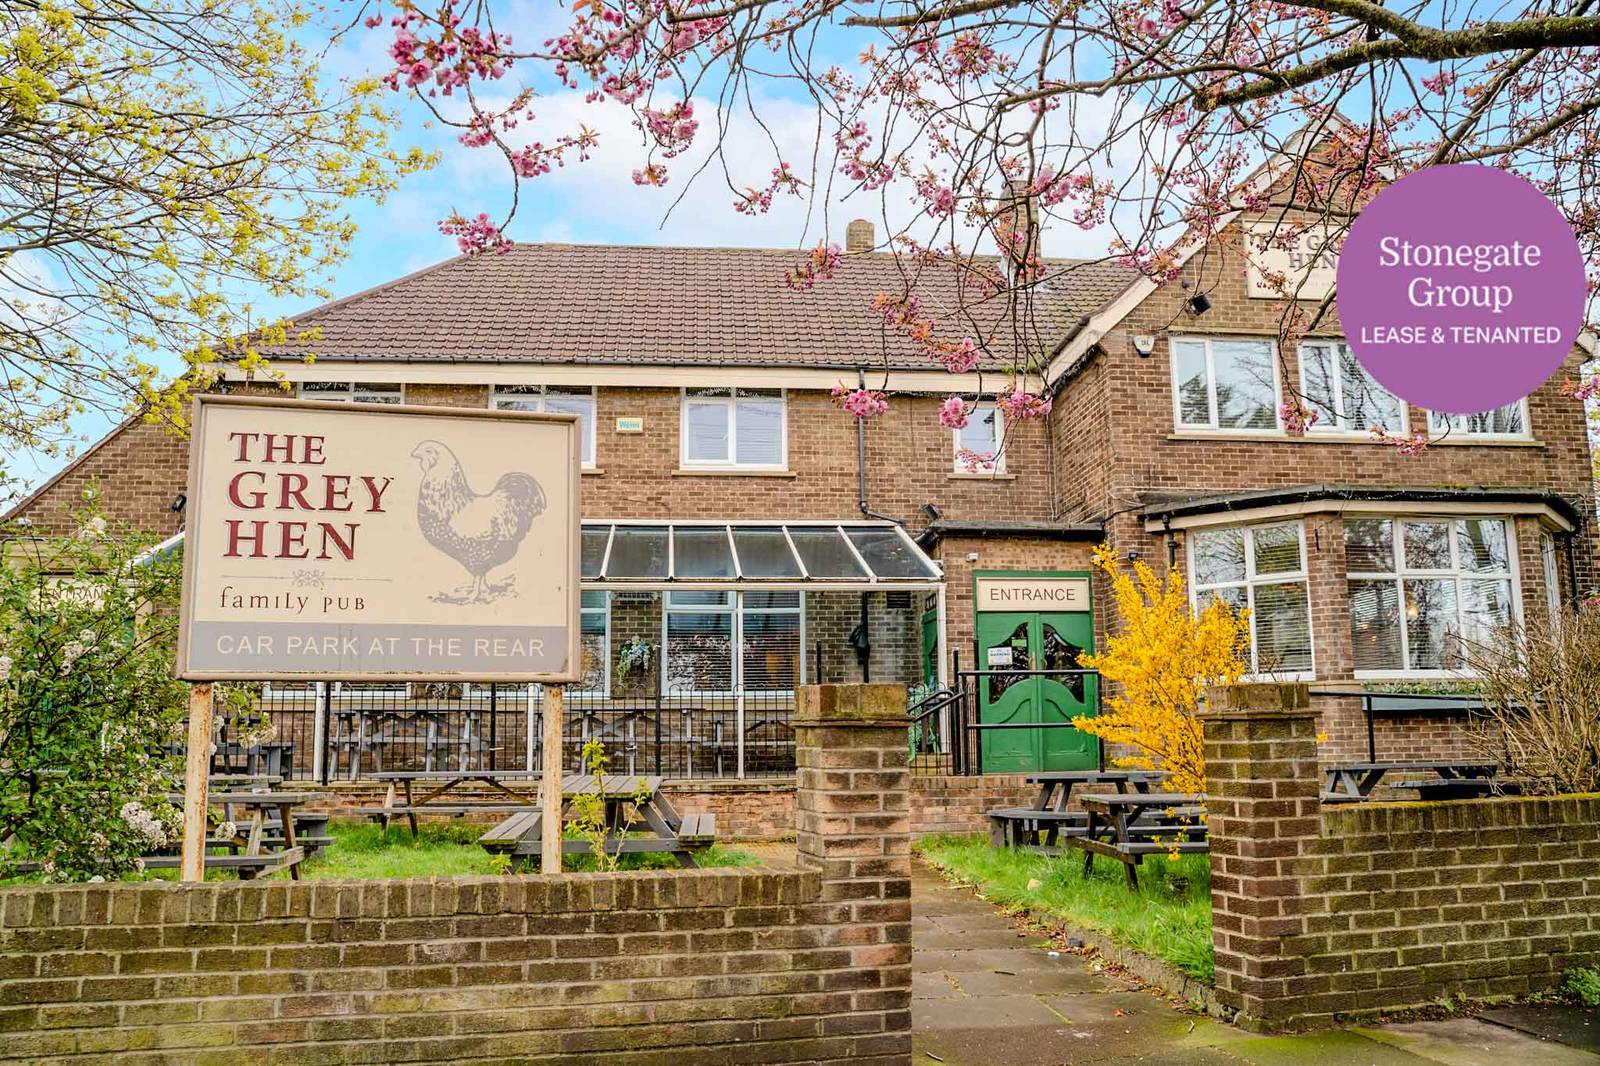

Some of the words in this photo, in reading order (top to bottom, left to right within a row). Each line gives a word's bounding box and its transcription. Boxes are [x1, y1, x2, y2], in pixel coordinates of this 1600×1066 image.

[229, 432, 327, 465] THE
[228, 471, 394, 512] GREY
[223, 519, 361, 560] HEN
[990, 588, 1076, 601] ENTRANCE
[216, 634, 274, 655] CAR
[286, 636, 358, 656] PARK
[368, 637, 400, 656] AT
[410, 637, 462, 657] THE
[474, 638, 545, 658] REAR
